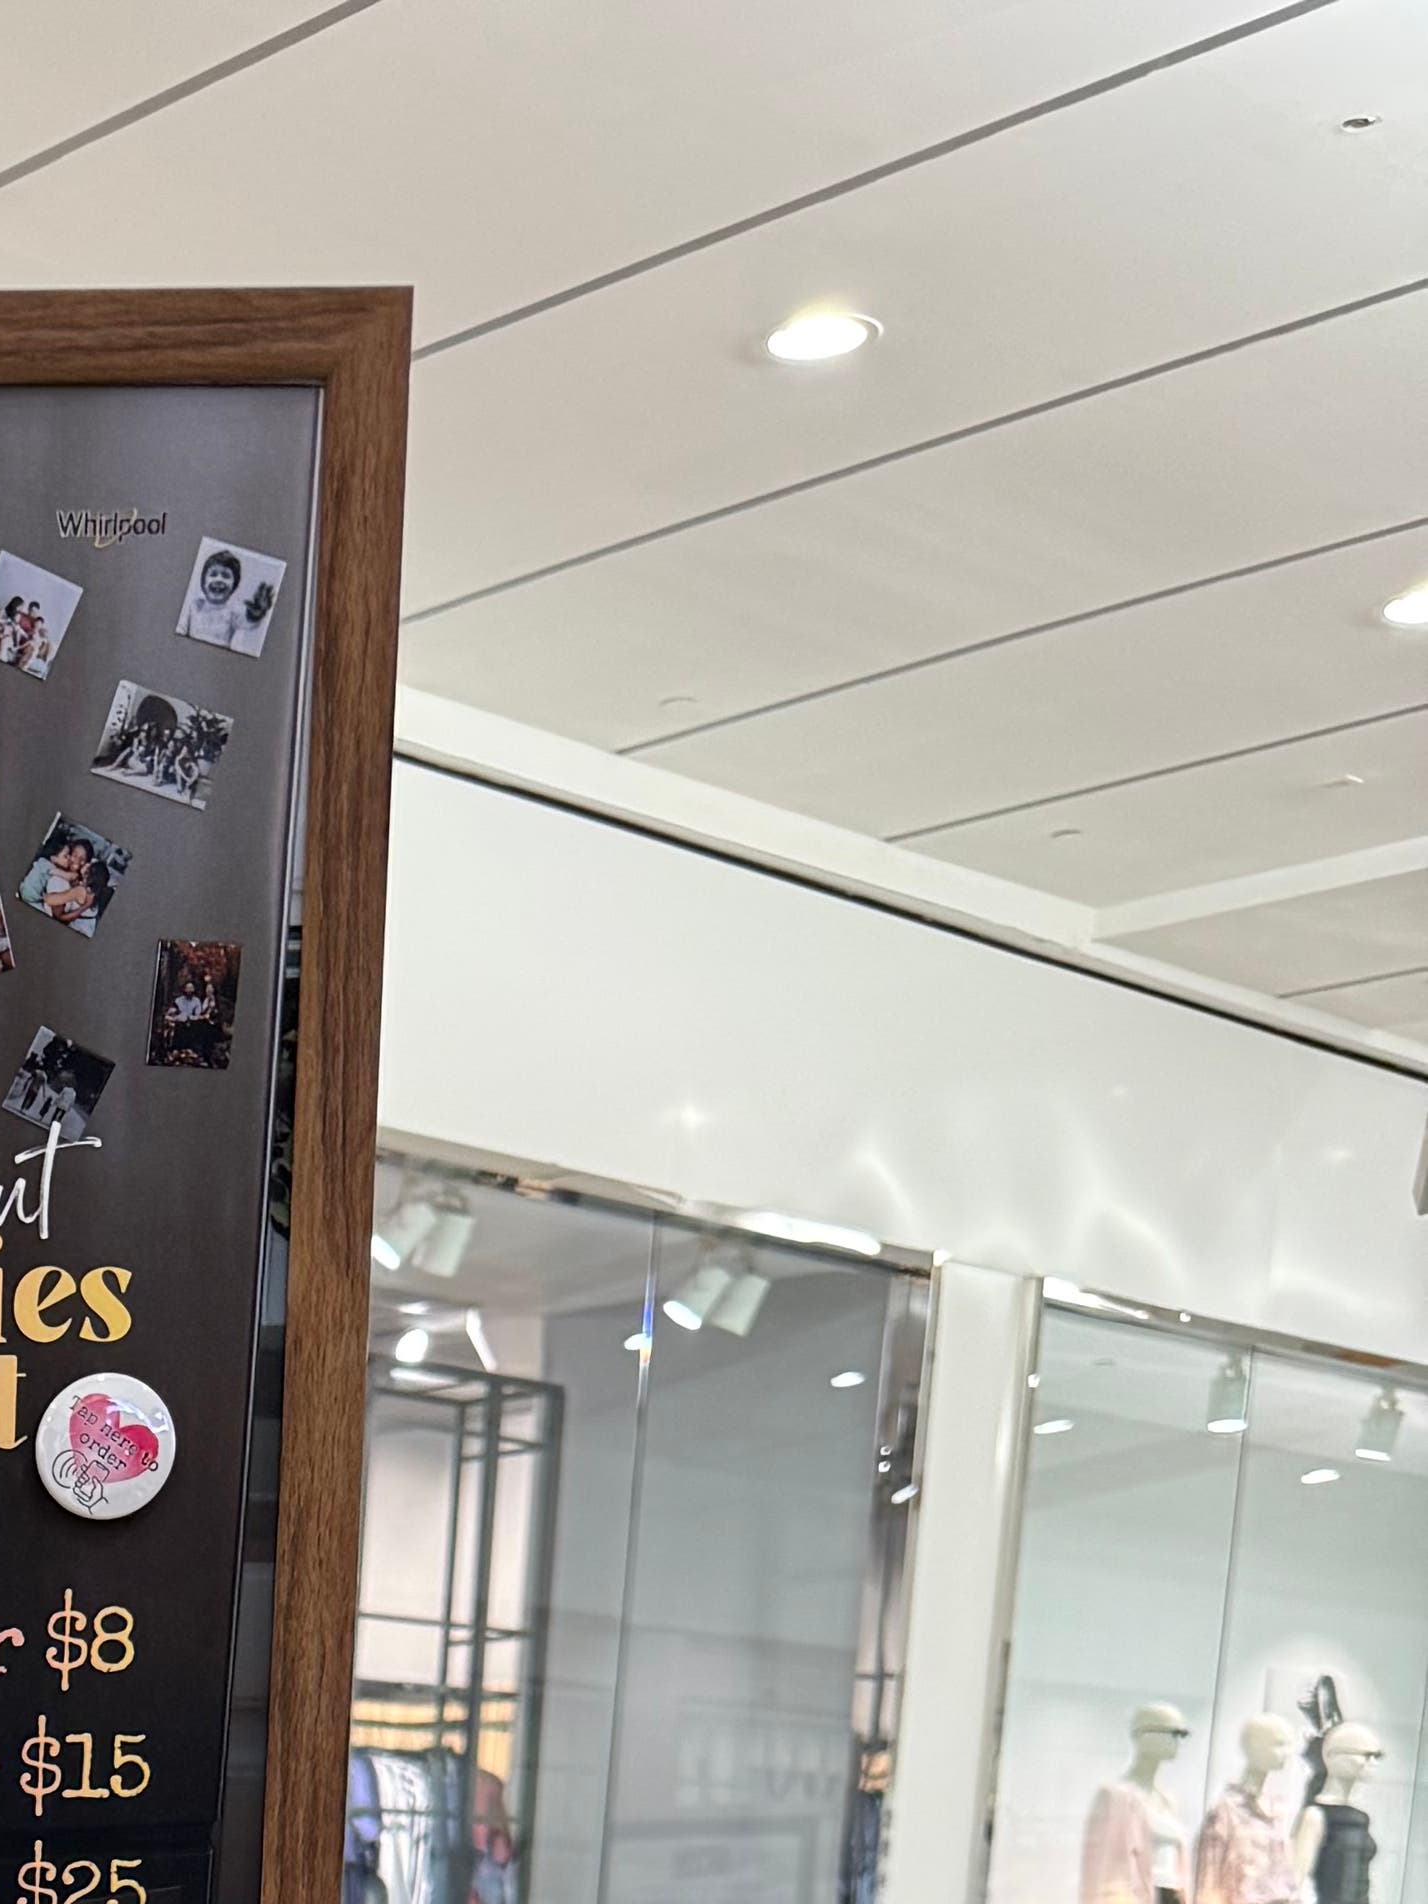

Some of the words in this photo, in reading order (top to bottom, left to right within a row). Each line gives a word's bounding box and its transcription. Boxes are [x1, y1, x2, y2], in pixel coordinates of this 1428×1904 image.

[56, 507, 168, 543] Whirlpool
[69, 1395, 98, 1425] Tap
[141, 1452, 159, 1472] to
[79, 1432, 126, 1471] order
[45, 1587, 136, 1691] $8
[19, 1714, 151, 1817] $15
